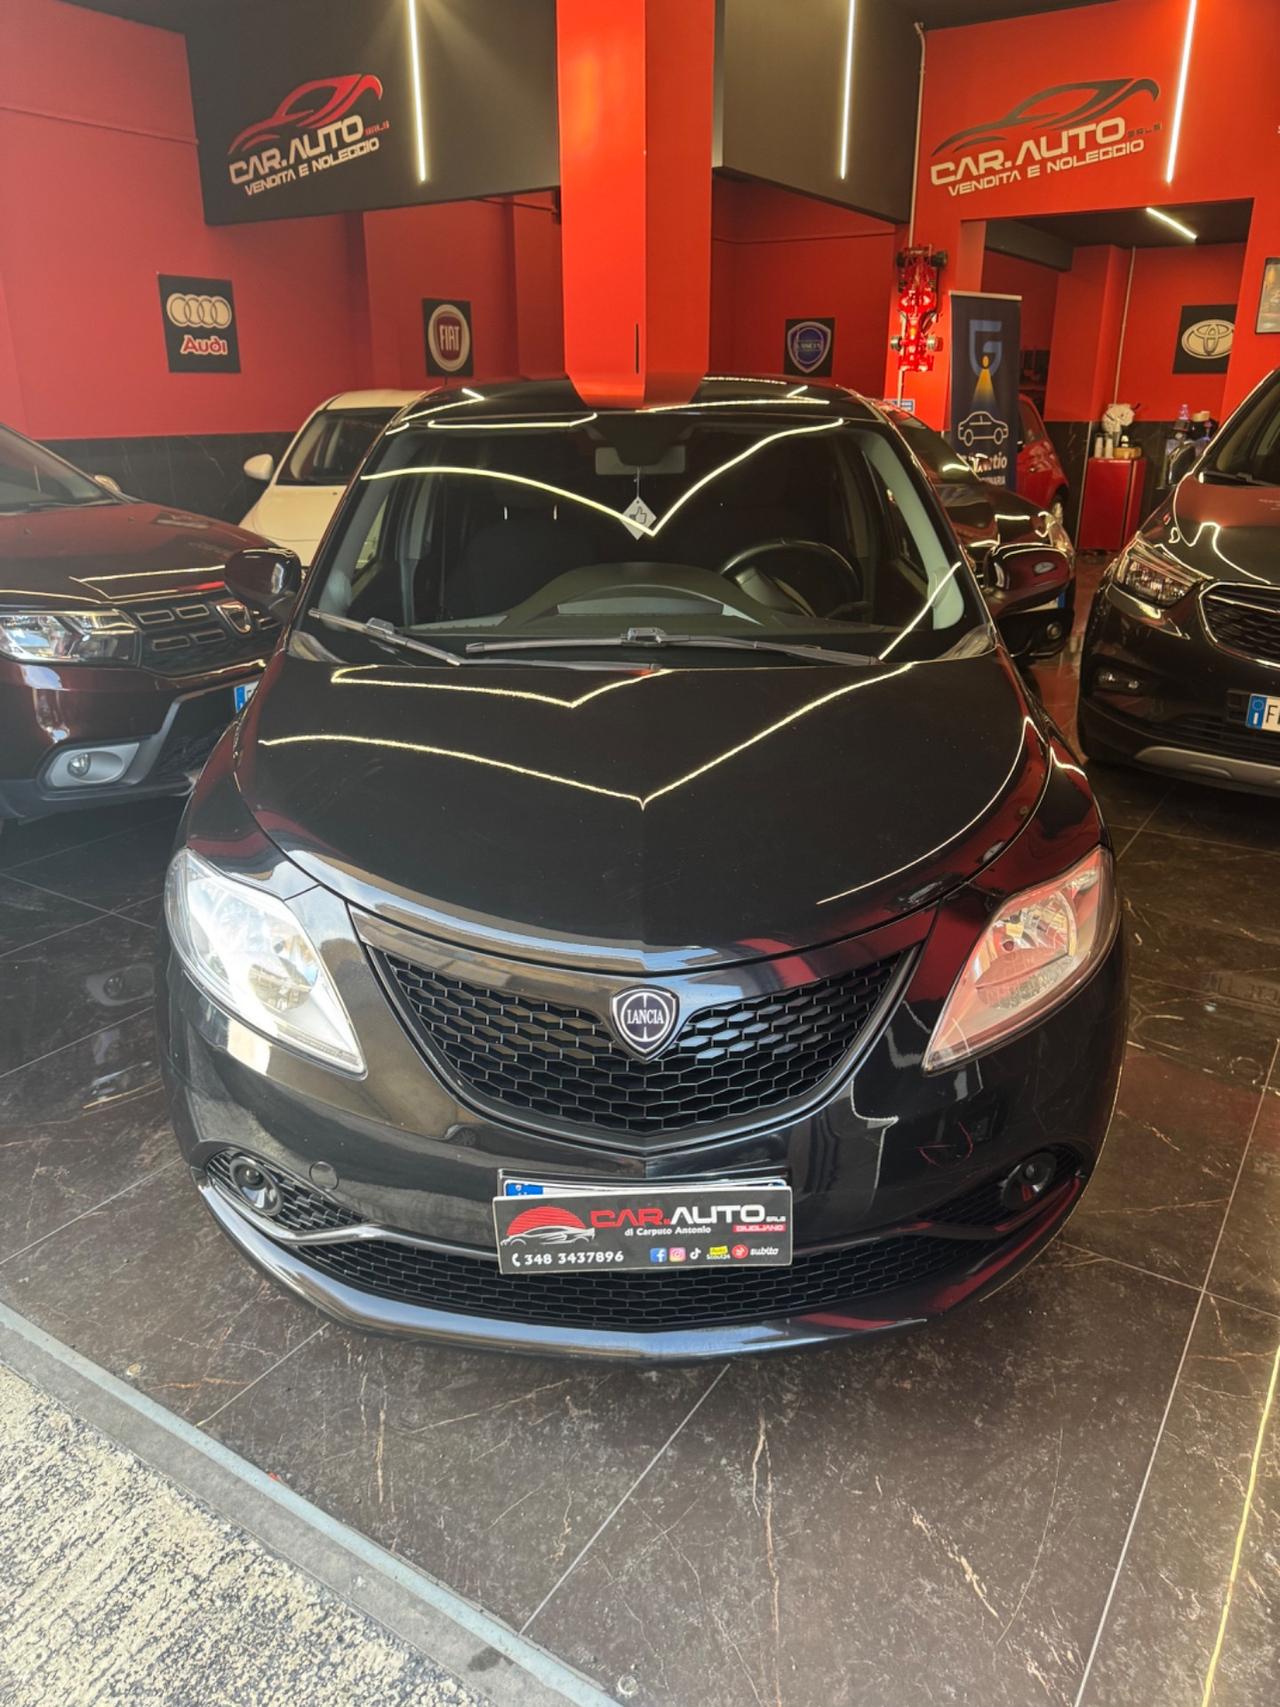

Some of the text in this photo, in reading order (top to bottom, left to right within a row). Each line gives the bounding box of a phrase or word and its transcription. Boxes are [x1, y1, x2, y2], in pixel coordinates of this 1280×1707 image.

[245, 137, 380, 196] VENDITA E NOLEGGIO
[948, 139, 1145, 196] VENDITA E NOLEGGIO
[181, 334, 228, 355] Audi
[439, 325, 460, 351] FIAT
[1266, 705, 1280, 725] F
[627, 1008, 665, 1025] LANCIA
[624, 1228, 634, 1236] di
[675, 1224, 712, 1236] Antonio
[524, 1251, 624, 1265] 348 3437896
[750, 1246, 779, 1256] subito
